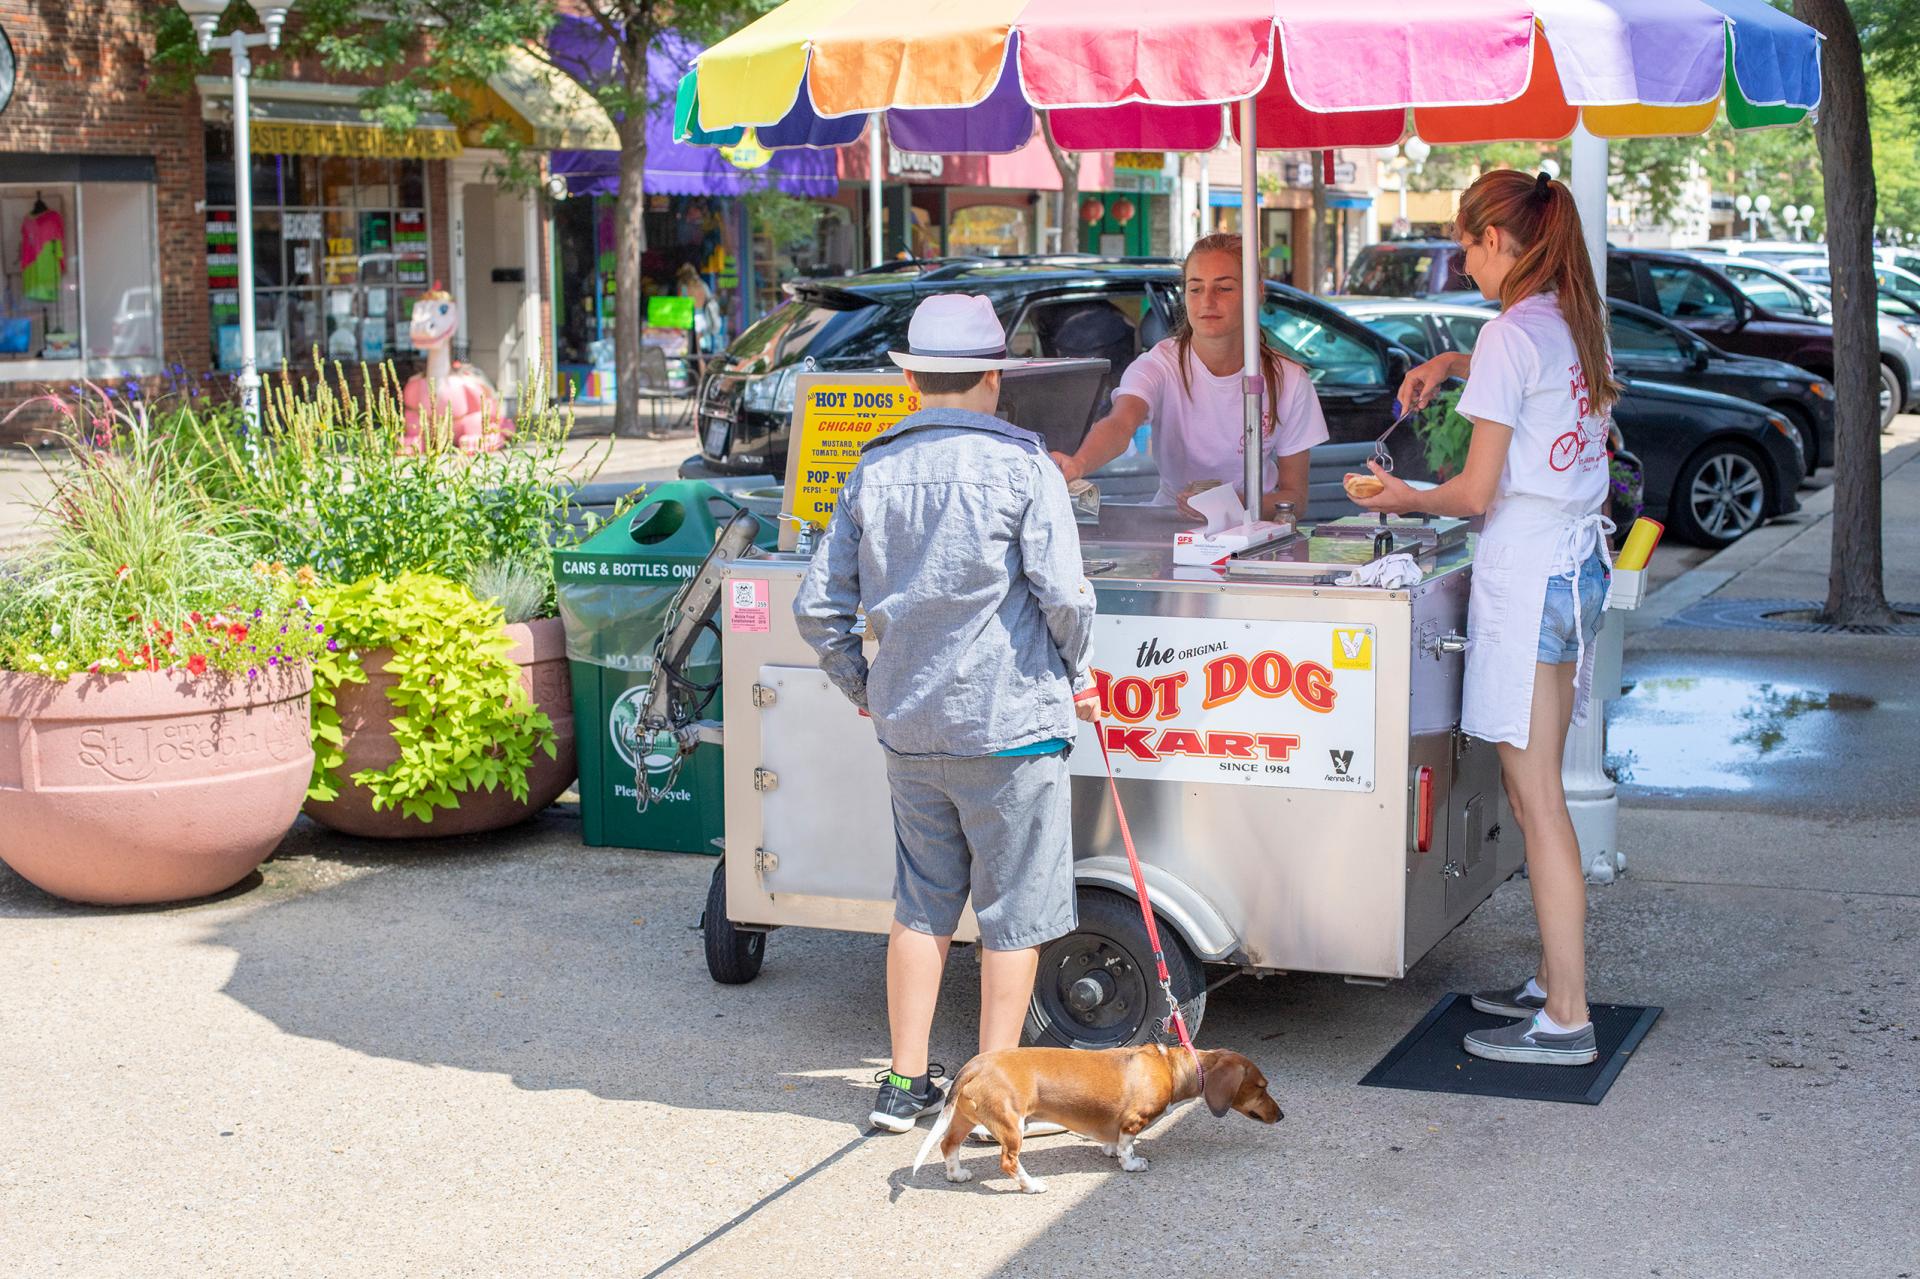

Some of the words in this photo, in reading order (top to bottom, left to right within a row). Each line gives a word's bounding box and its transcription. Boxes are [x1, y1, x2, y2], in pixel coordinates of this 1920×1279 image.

[815, 392, 847, 407] HOT
[853, 393, 893, 408] DOGS
[818, 421, 872, 433] CHICAGO
[821, 440, 854, 448] MUSTARD,
[814, 502, 836, 513] CH
[562, 561, 597, 576] CANS
[599, 562, 609, 576] &
[612, 563, 669, 577] BOTTLES
[672, 564, 701, 578] ONL
[1136, 636, 1175, 669] the
[1178, 640, 1229, 660] ORIGINAL
[605, 654, 629, 669] NO
[1202, 650, 1338, 713] DOG
[163, 724, 204, 738] CITY
[1105, 726, 1300, 762] KART
[1219, 762, 1258, 772] SINCE
[1264, 763, 1291, 774] 1984
[650, 787, 691, 802] Rcycle
